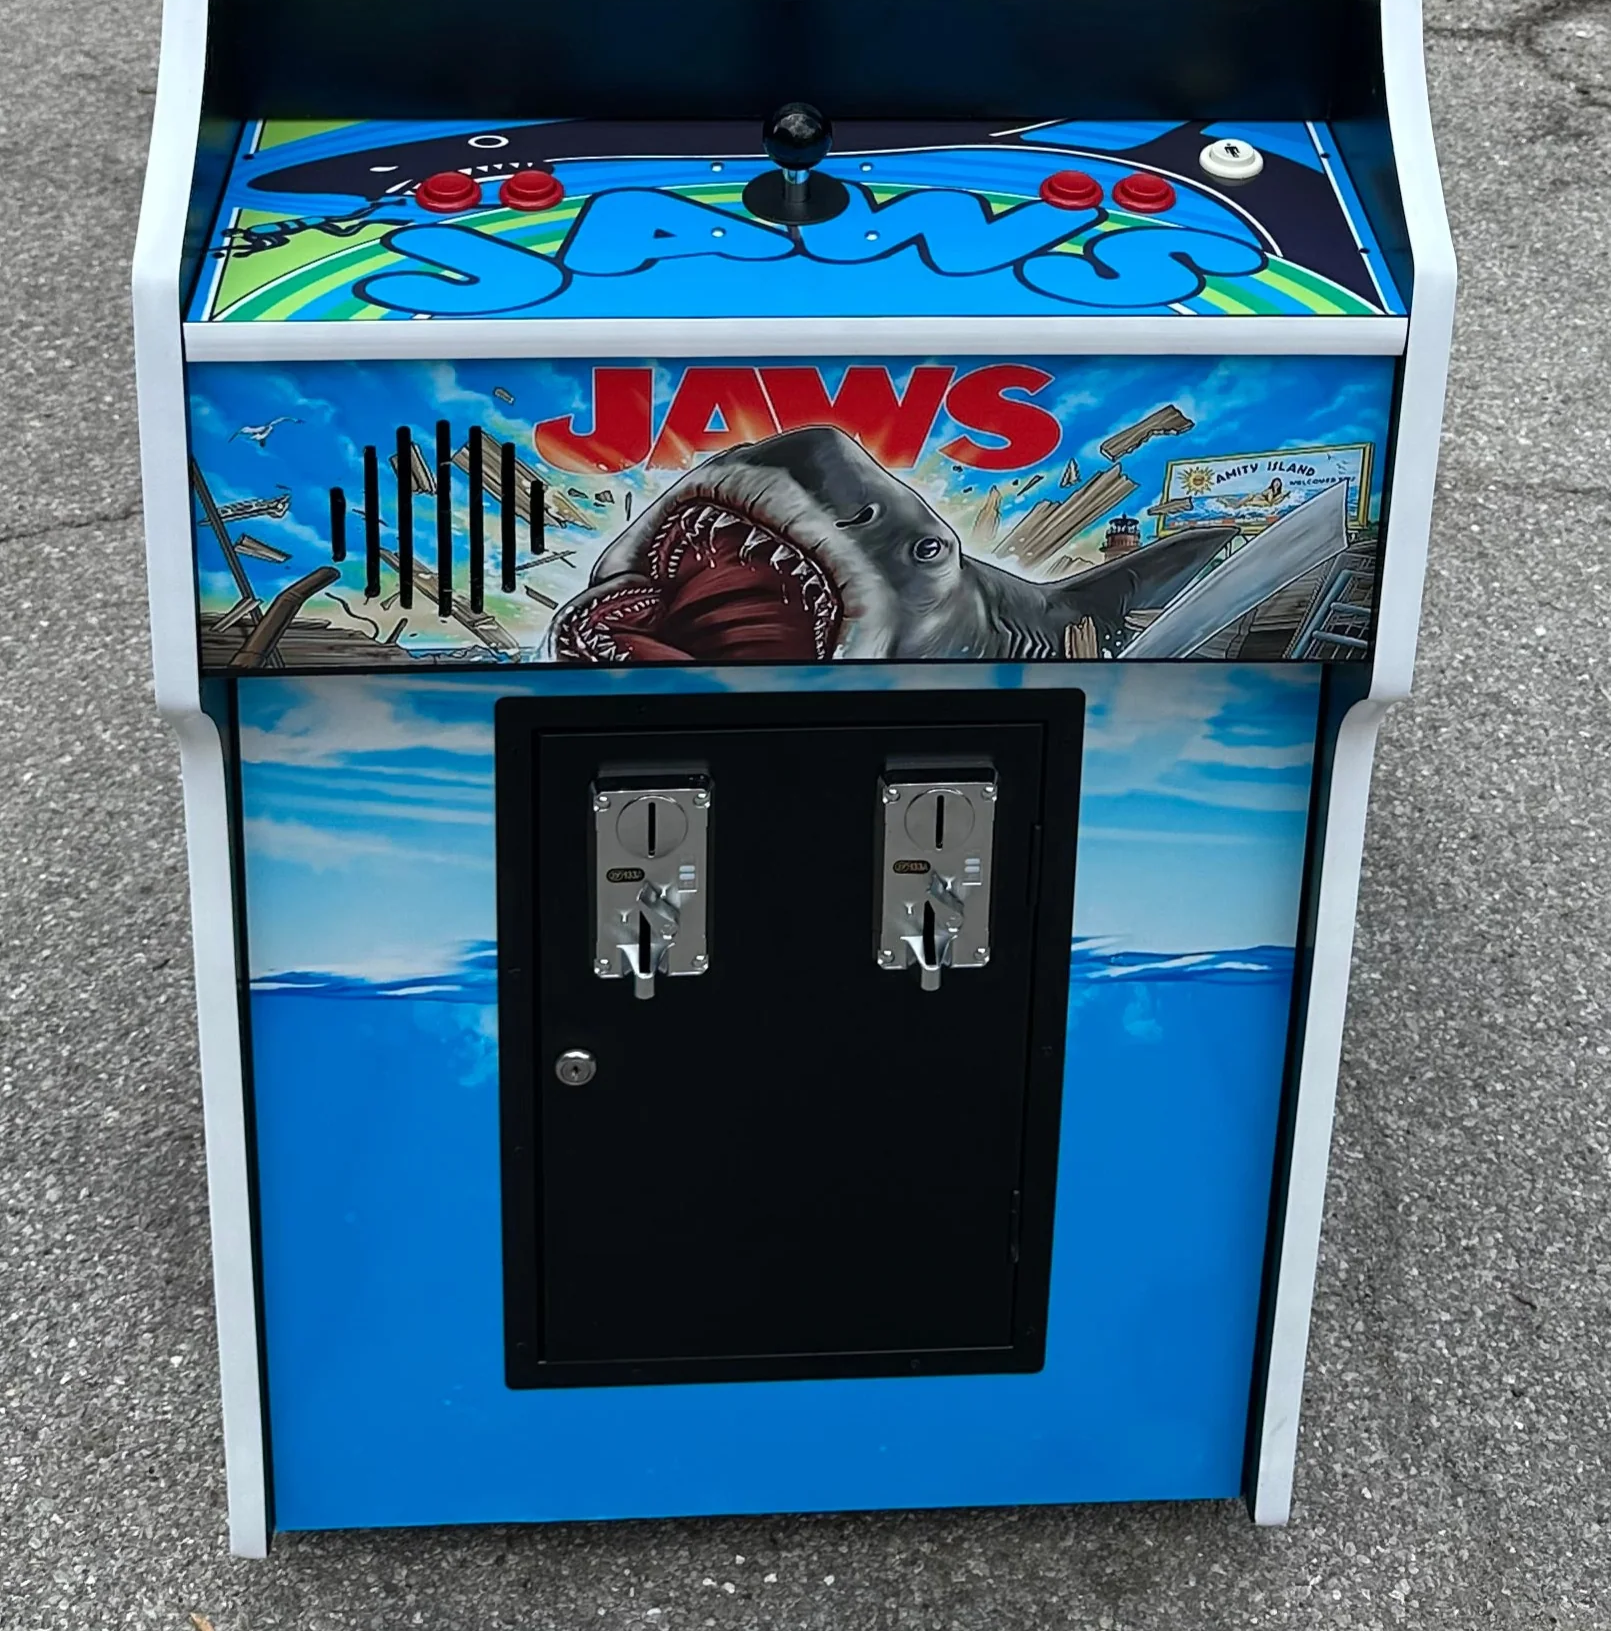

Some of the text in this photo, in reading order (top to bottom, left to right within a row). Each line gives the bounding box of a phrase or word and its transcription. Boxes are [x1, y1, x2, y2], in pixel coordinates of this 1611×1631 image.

[353, 186, 1268, 314] JAWS
[533, 363, 1062, 475] JAWS
[1216, 461, 1316, 484] AMITY ISLAND
